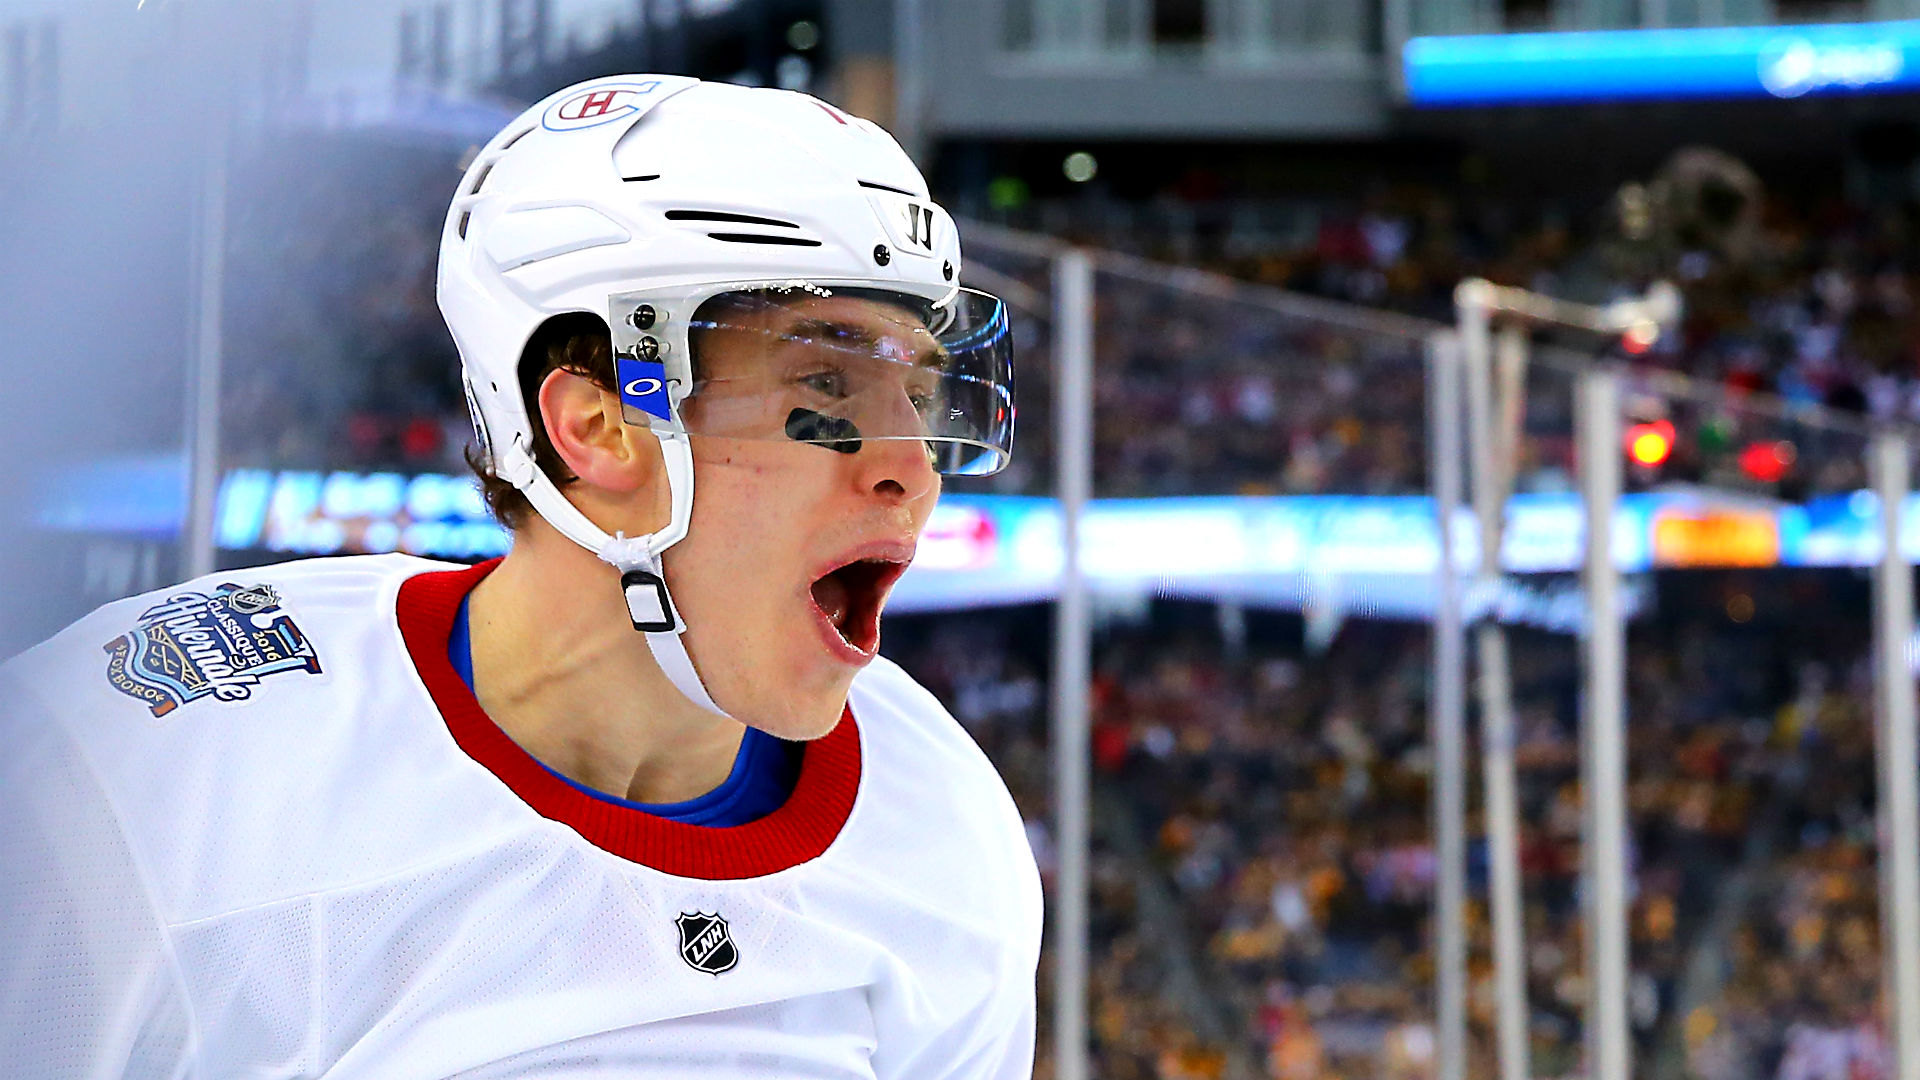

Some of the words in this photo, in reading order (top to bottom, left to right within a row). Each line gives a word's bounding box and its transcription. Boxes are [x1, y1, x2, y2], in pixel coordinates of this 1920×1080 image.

[139, 592, 257, 700] Hivernale
[206, 599, 264, 667] CLASSIQUE
[252, 631, 283, 662] 2016
[110, 649, 158, 699] FOXBORO
[691, 923, 723, 962] LNH
